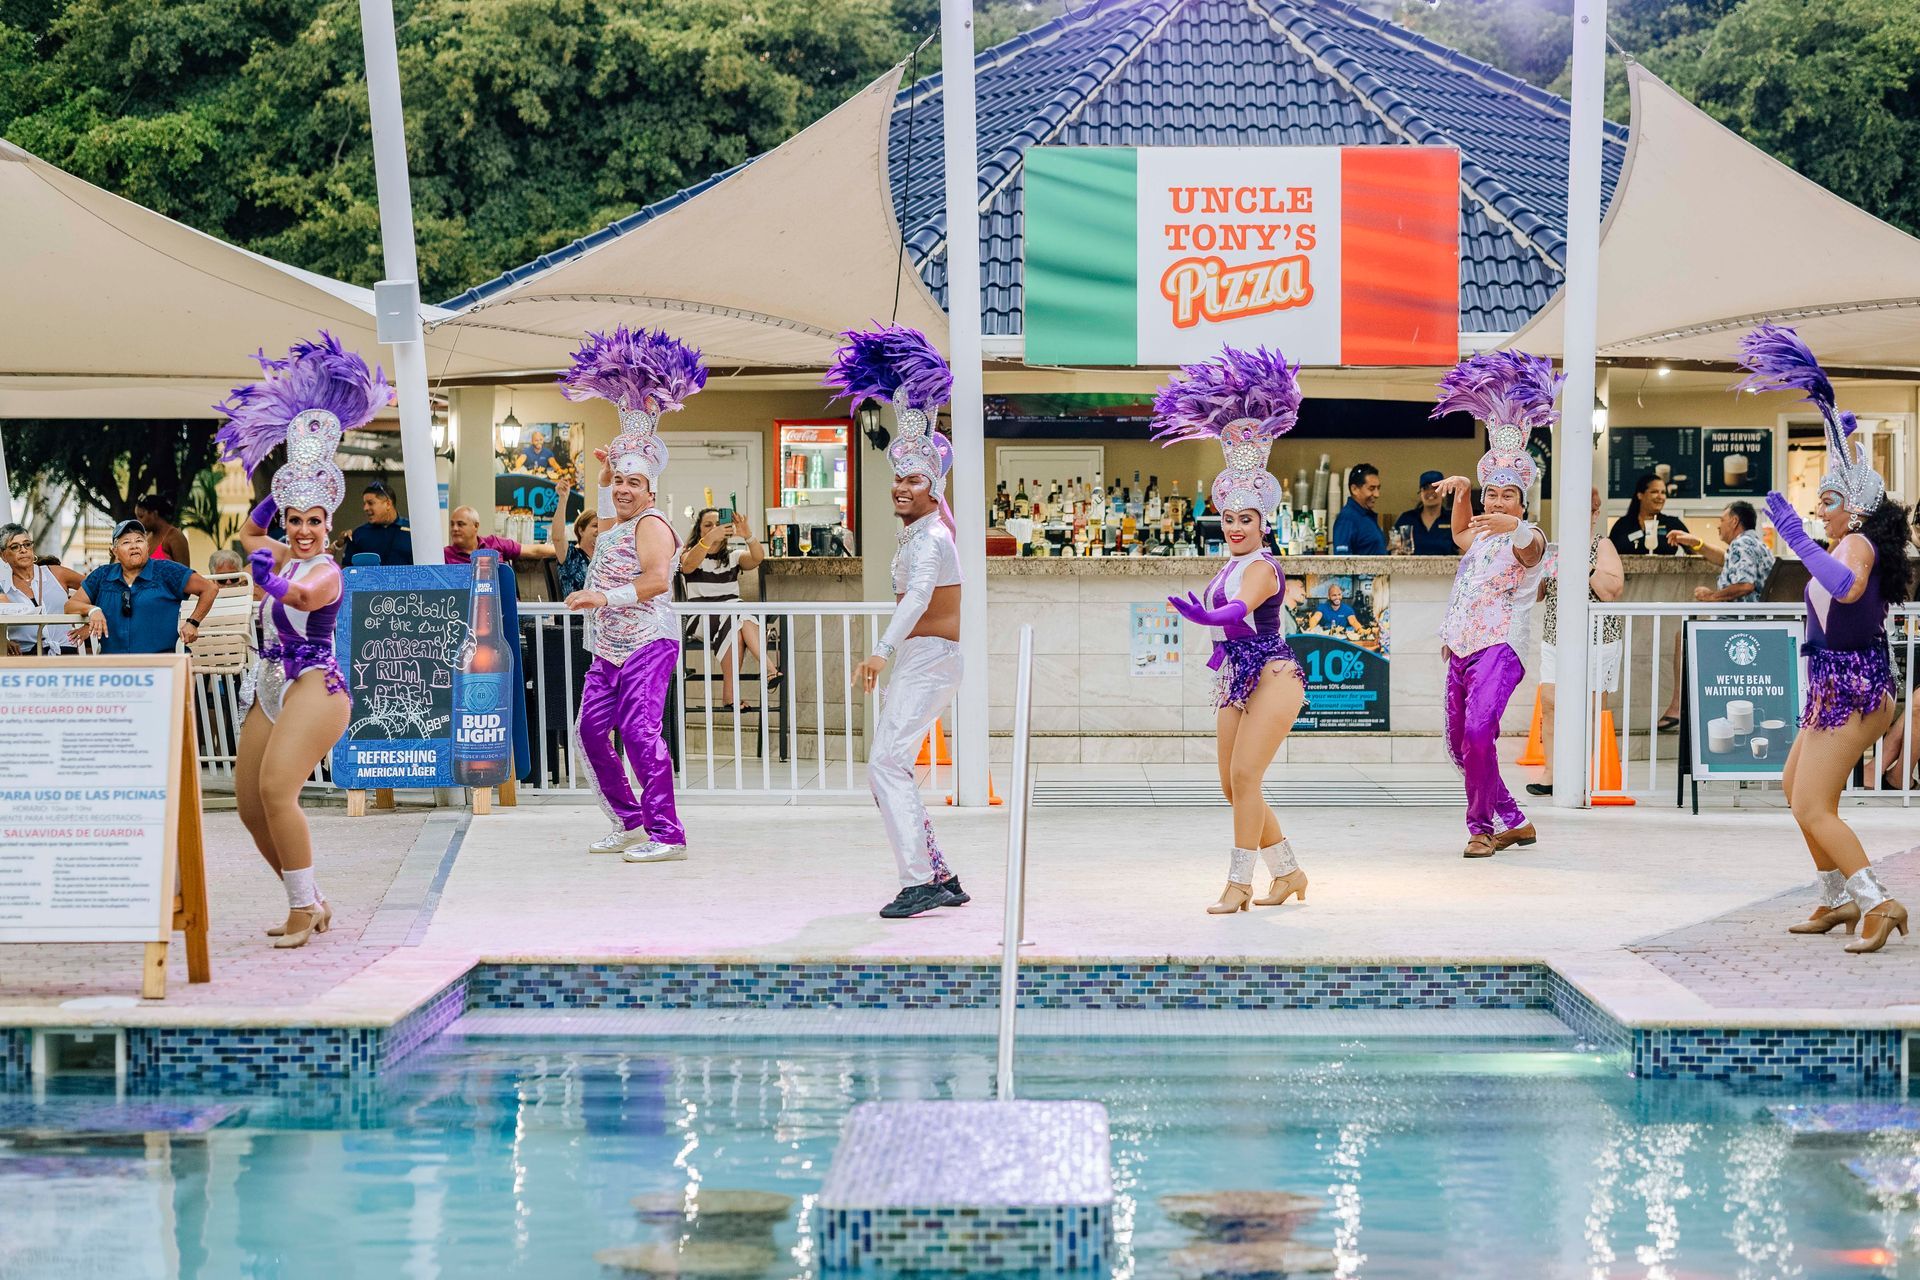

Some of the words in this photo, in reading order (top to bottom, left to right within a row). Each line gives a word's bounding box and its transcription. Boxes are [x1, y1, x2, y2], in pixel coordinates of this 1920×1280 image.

[1168, 187, 1313, 214] UNCLE
[1164, 223, 1317, 251] TONY'S
[1161, 256, 1313, 327] Pizza
[1711, 432, 1729, 442] NOW
[1730, 432, 1761, 442] SERVING
[1711, 443, 1729, 452] JUST
[1730, 443, 1744, 452] FOR
[1746, 443, 1761, 452] YOU
[389, 616, 414, 631] the
[1306, 649, 1364, 682] 10%
[1, 675, 21, 687] ES
[25, 675, 59, 687] FOR
[62, 675, 95, 687] THE
[99, 674, 155, 687] POOLS
[1343, 670, 1362, 679] OFF
[1716, 675, 1745, 685] WE'VE
[1746, 675, 1772, 685] BEAN
[1704, 686, 1744, 696] WAITING
[1746, 686, 1764, 696] FOR
[1765, 686, 1784, 696] YOU
[1, 706, 9, 714] O
[12, 705, 74, 714] LIFEGUARD
[76, 705, 93, 714] ON
[96, 704, 128, 714] DUTY
[462, 714, 501, 729] BUD
[456, 728, 506, 743] LIGHT
[357, 750, 437, 764] REFRESHING
[357, 767, 404, 777] AMERICAN
[407, 766, 436, 777] LAGER
[0, 790, 31, 800] PARA
[35, 791, 62, 800] USO
[65, 791, 81, 800] DE
[85, 790, 110, 800] LAS
[113, 790, 166, 800] PICINAS
[3, 829, 73, 838] SALVAVIDAS
[76, 829, 90, 838] DE
[94, 828, 145, 837] GUARDIA
